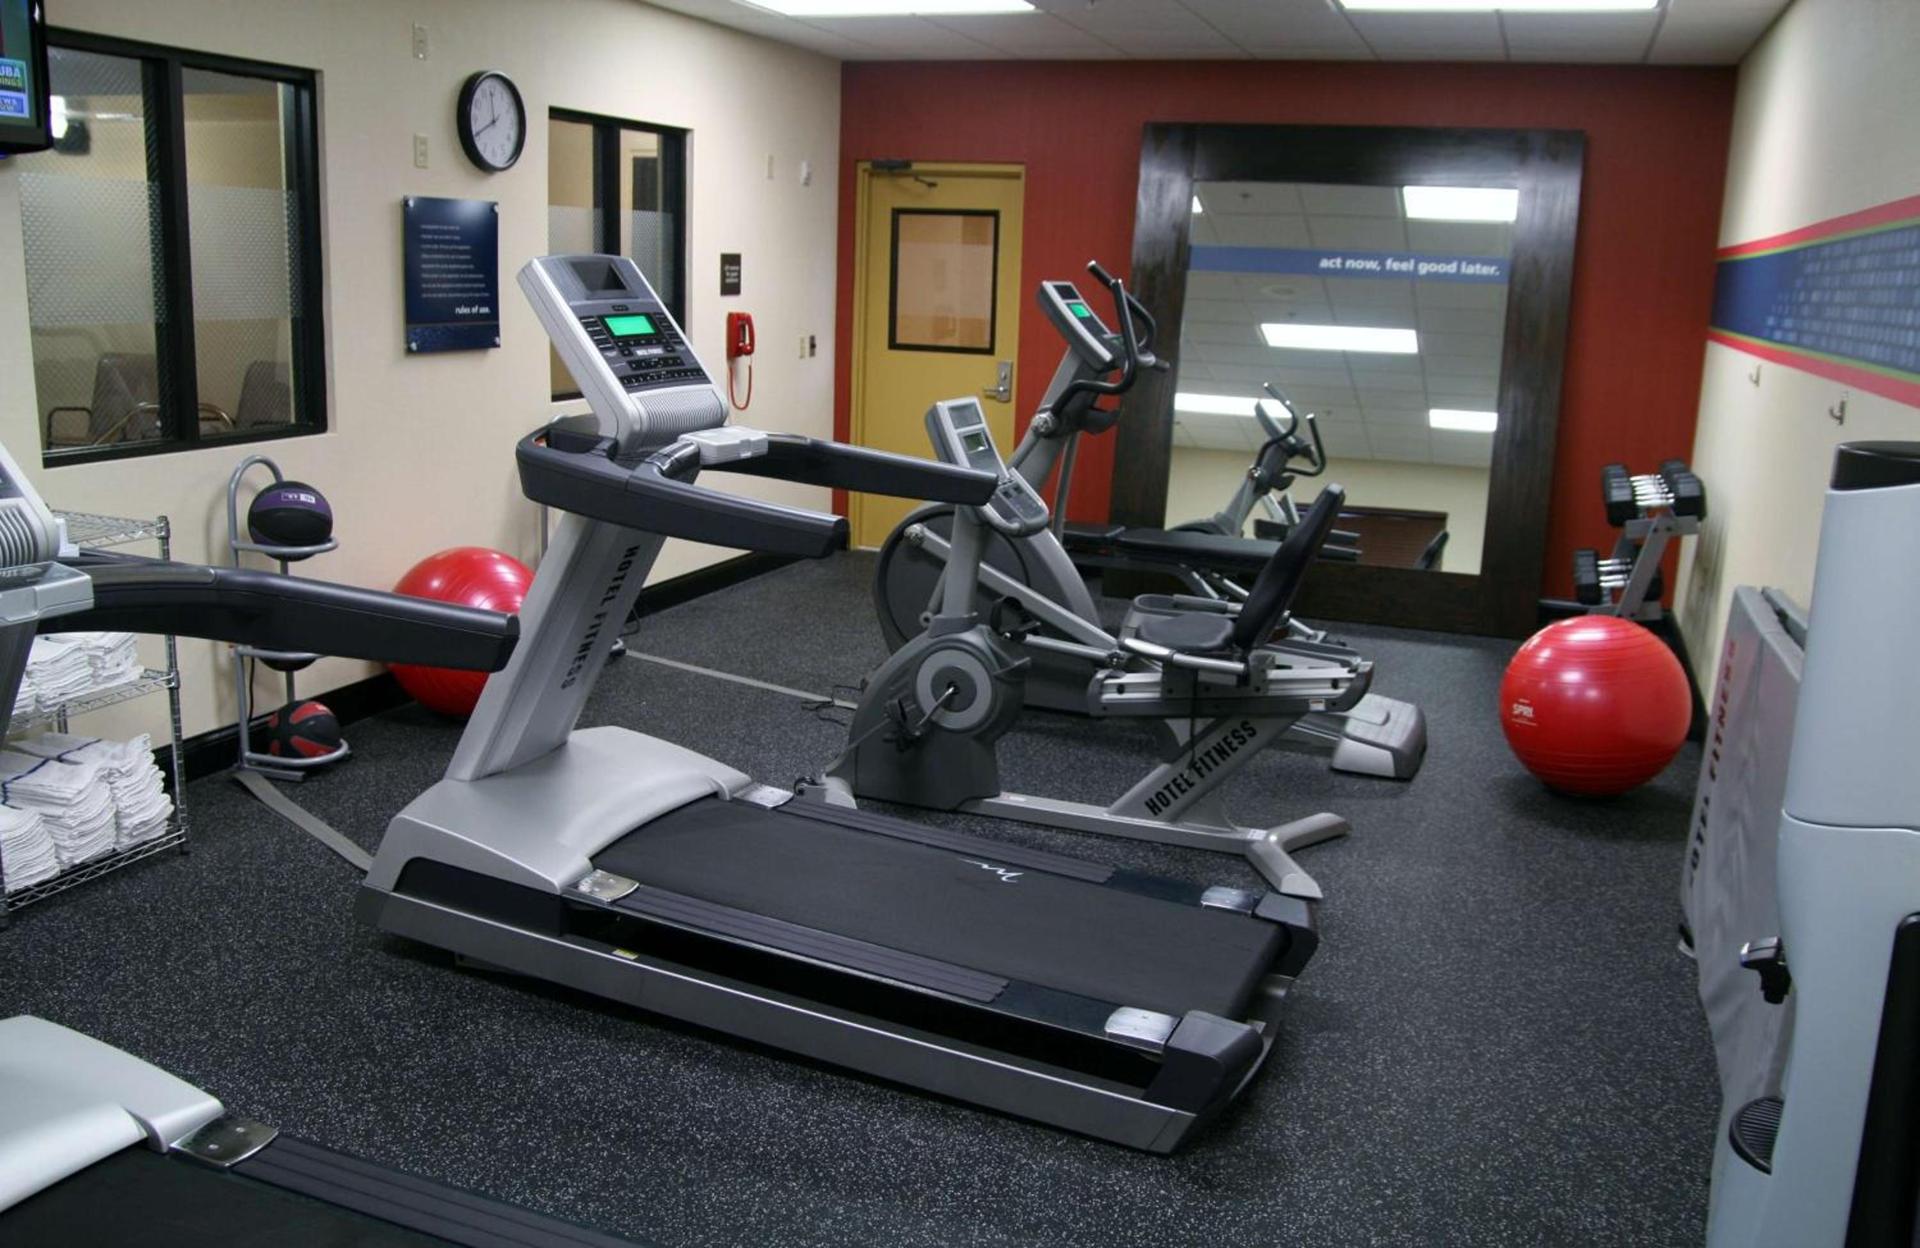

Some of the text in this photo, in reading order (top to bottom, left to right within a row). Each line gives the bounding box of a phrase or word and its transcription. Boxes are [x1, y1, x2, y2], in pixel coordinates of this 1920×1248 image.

[1319, 257, 1500, 276] act now, feel good later.
[560, 545, 641, 690] HOTEL FITNESS
[1144, 720, 1257, 816] HOTEL FITNESS
